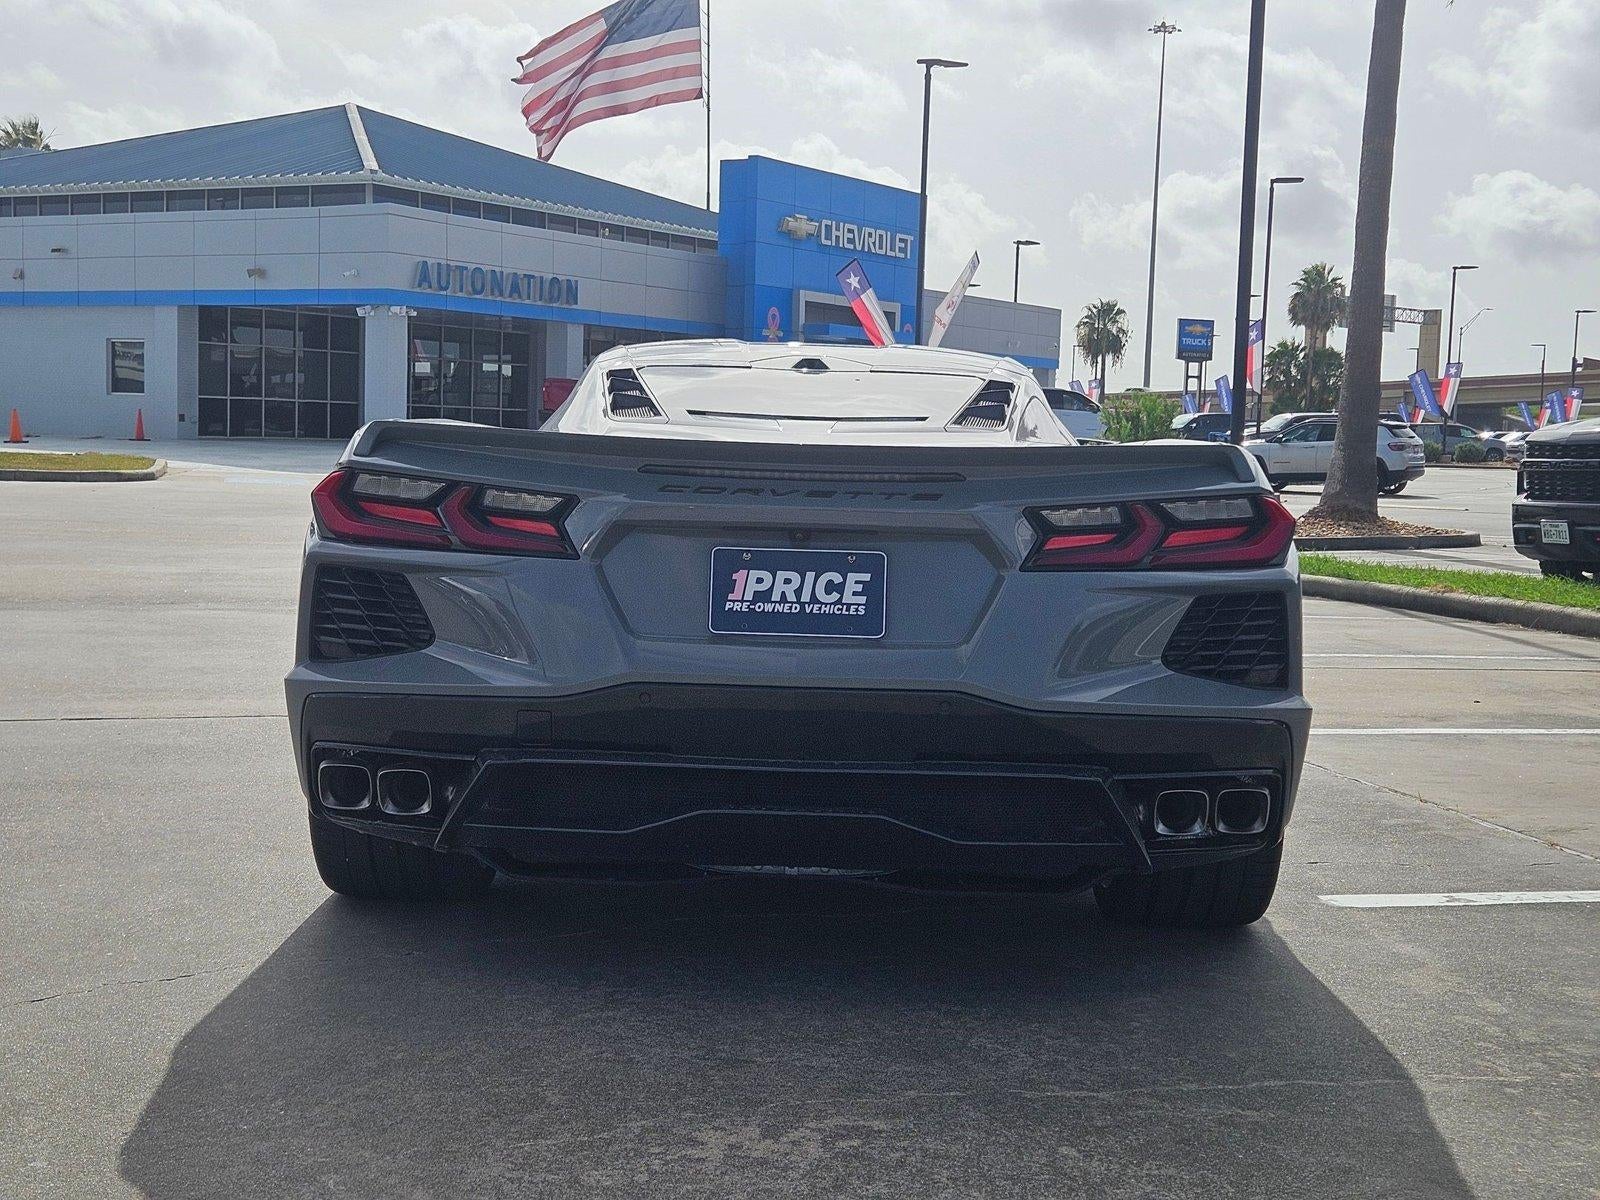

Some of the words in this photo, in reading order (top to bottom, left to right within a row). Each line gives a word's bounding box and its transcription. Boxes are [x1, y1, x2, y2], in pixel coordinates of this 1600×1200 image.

[820, 219, 914, 260] CHEVROLET
[414, 260, 579, 306] AUTONATION
[656, 485, 944, 501] CORVETTE
[725, 601, 800, 614] PRE-OWNED
[804, 603, 866, 615] VEHICLES
